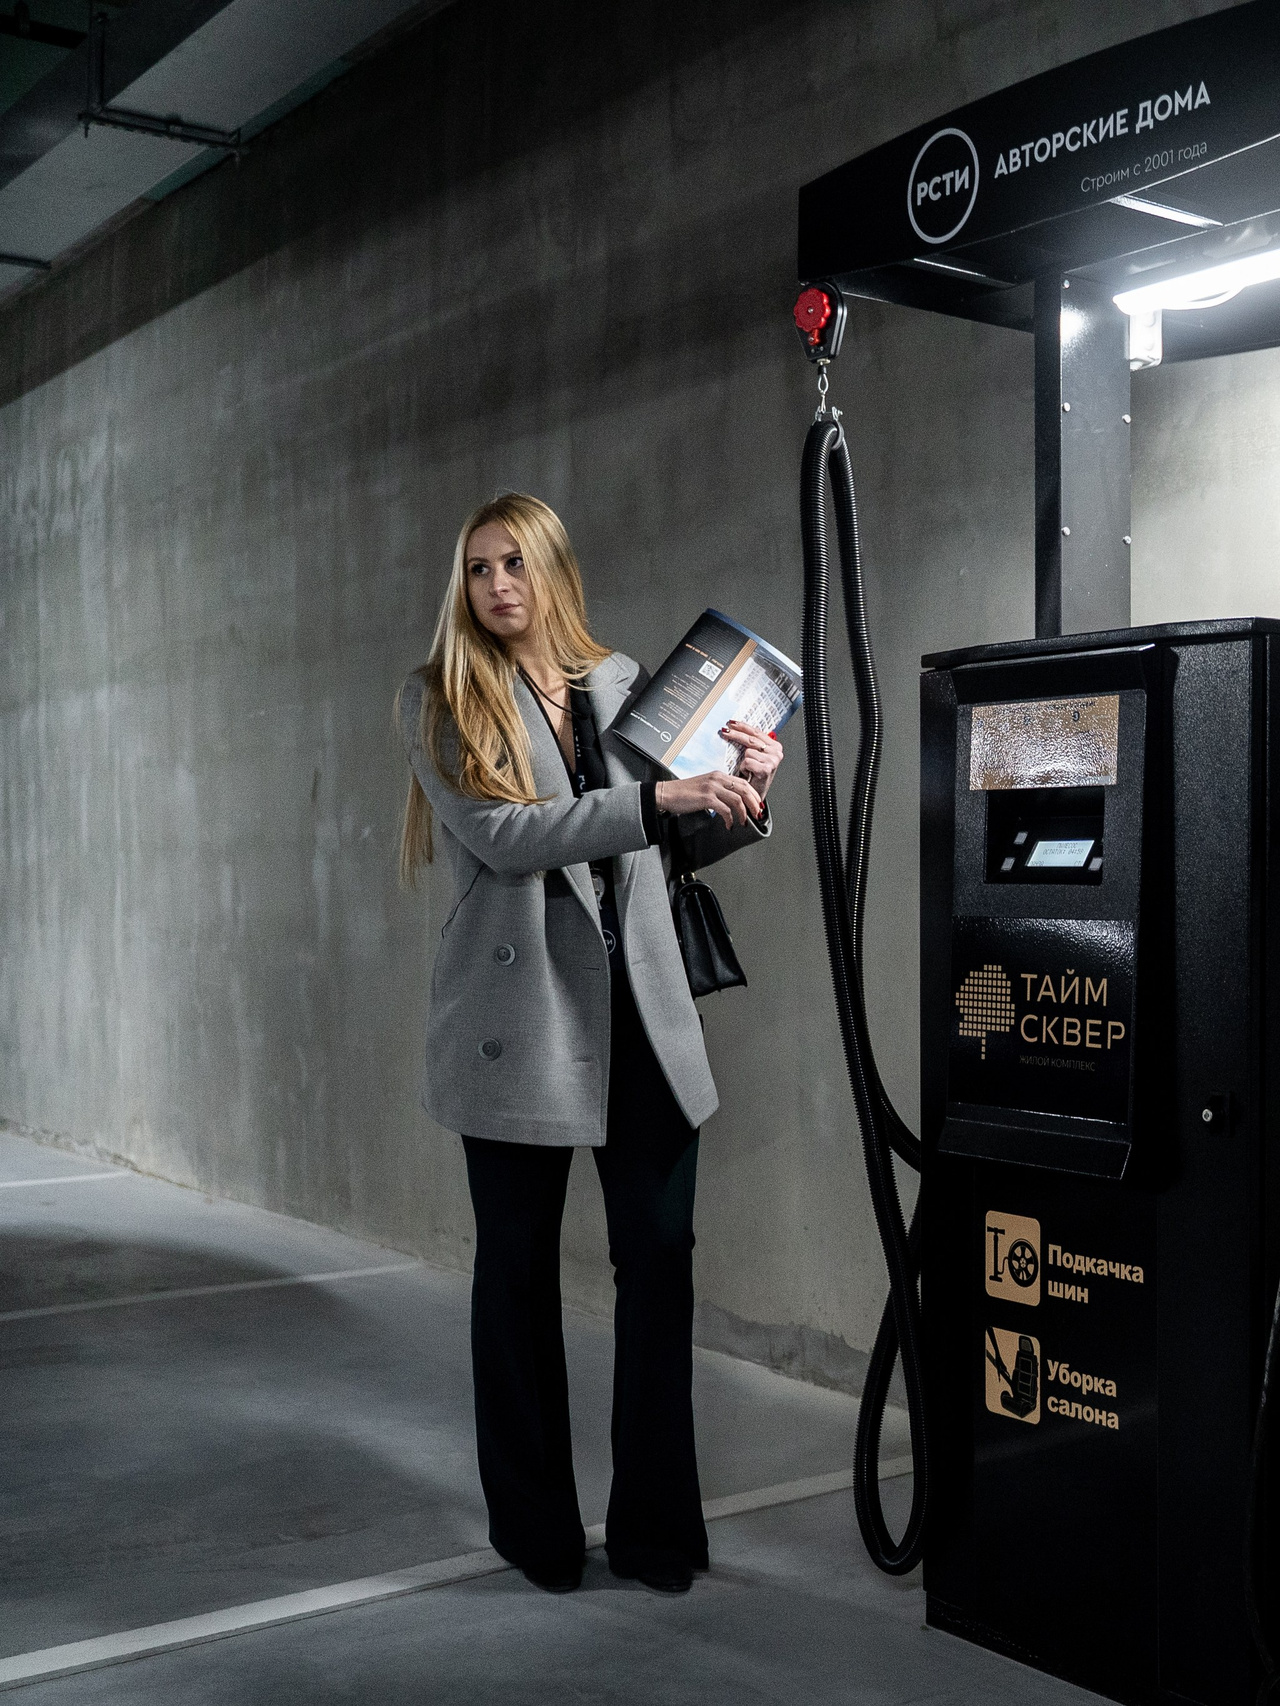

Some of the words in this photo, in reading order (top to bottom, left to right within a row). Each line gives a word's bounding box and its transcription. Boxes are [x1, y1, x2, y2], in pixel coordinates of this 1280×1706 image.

[994, 108, 1129, 179] АВТОРСКИЕ
[1135, 81, 1211, 134] ДОМА
[916, 165, 970, 206] РСТИ
[1080, 166, 1130, 193] Строим
[1133, 163, 1142, 177] с
[1144, 149, 1174, 173] 2001
[1178, 140, 1208, 163] года
[1020, 968, 1108, 1007] ТАЙМ
[1020, 1014, 1126, 1050] СКВЕР
[1019, 1055, 1050, 1067] ЖИЛОЙ
[1051, 1057, 1096, 1072] КОМПЛЕКС
[1048, 1243, 1145, 1284] Подкачка
[1047, 1280, 1089, 1304] шин
[1046, 1358, 1117, 1398] Уборка
[1047, 1396, 1120, 1430] салона
